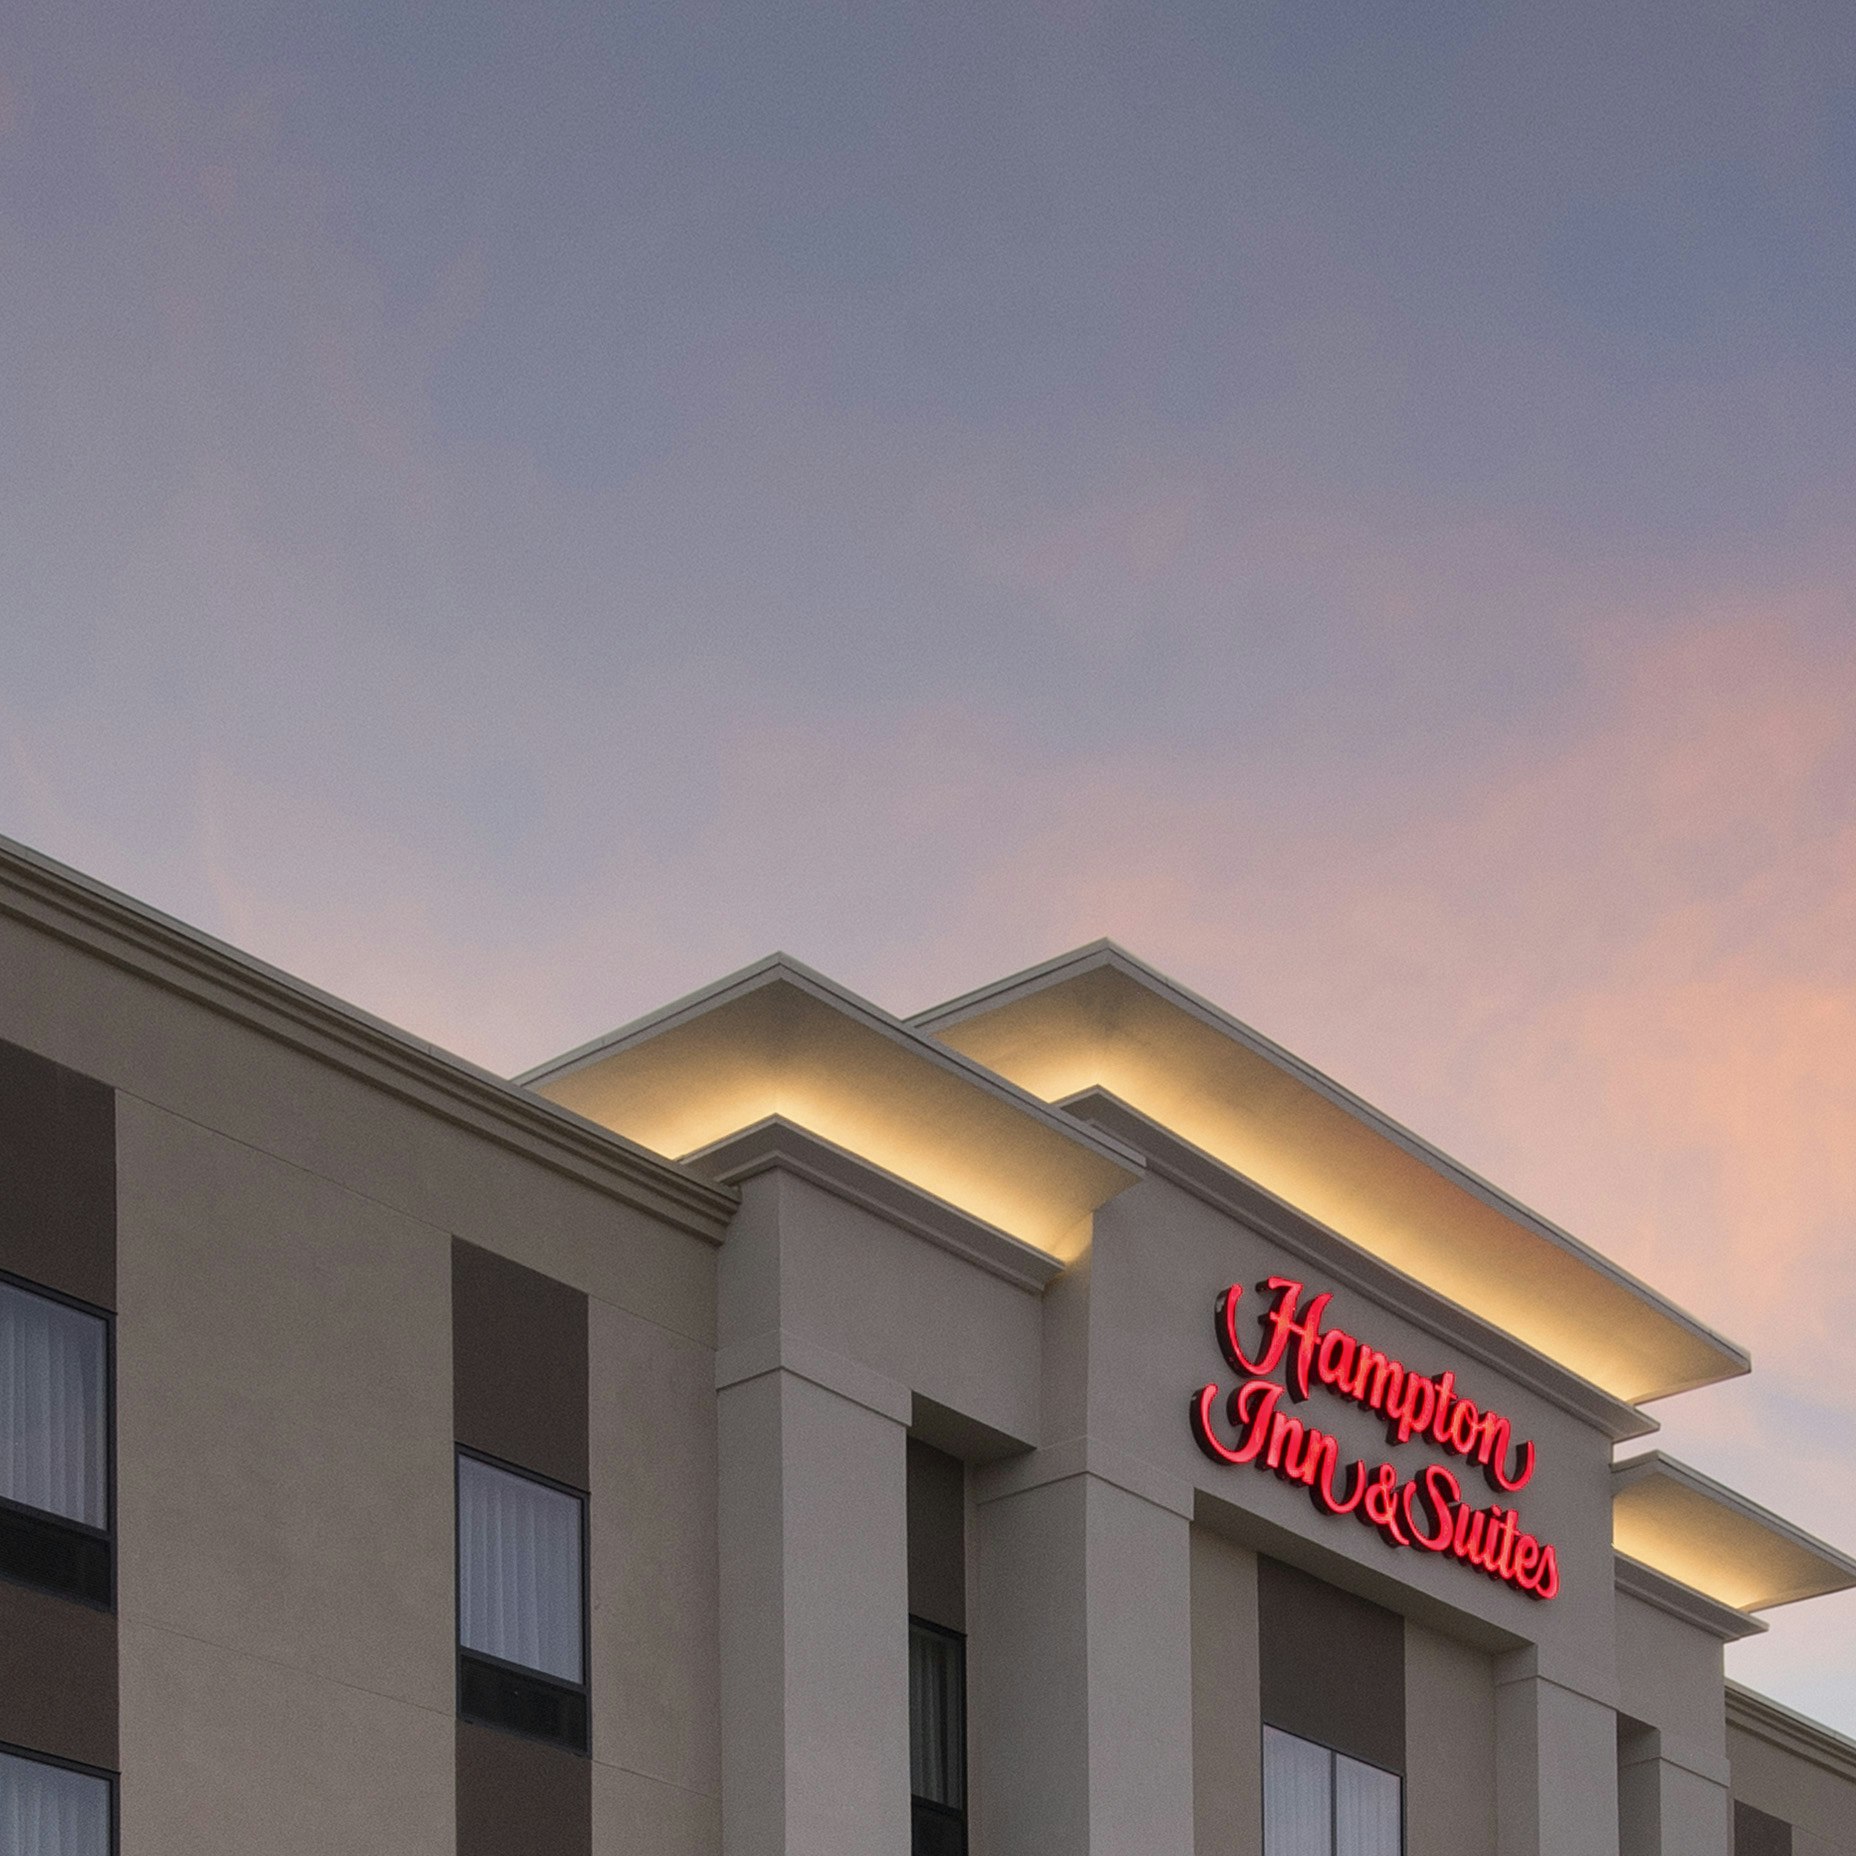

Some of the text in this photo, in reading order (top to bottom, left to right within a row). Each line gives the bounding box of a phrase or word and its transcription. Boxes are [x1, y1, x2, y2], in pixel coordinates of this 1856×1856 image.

[1189, 1380, 1560, 1600] Inn & Suites
[1214, 1275, 1535, 1492] Hampton
